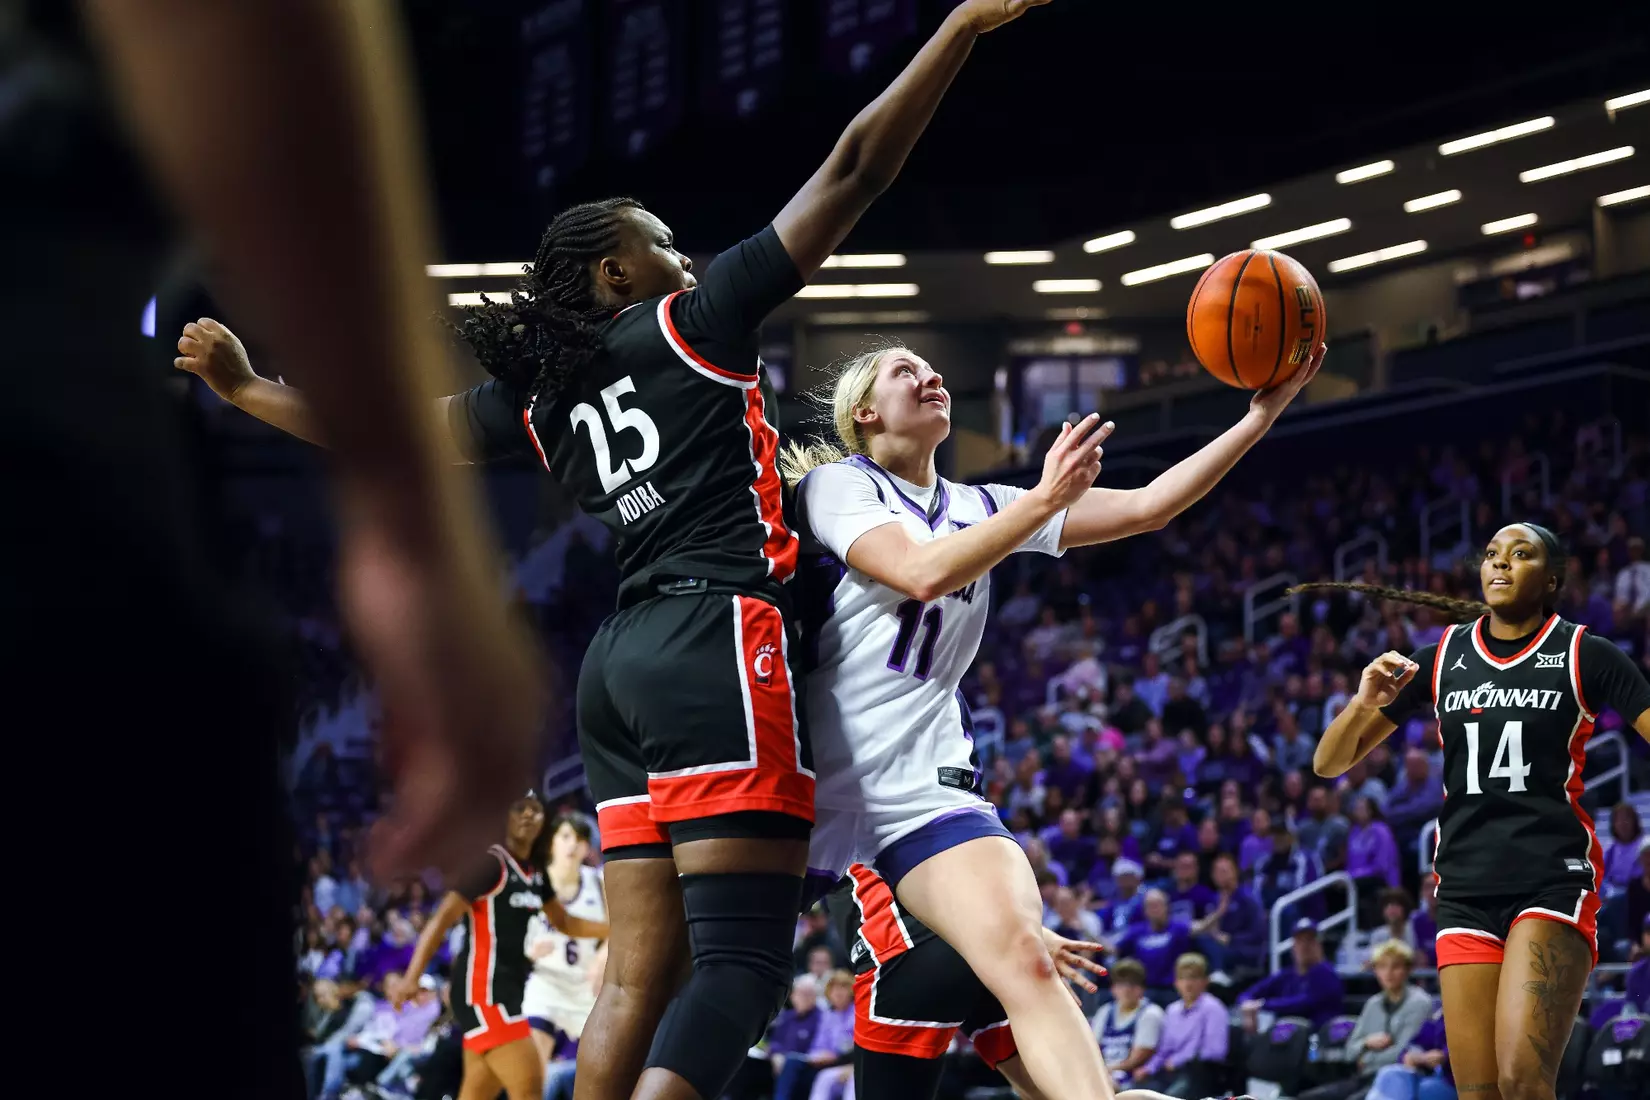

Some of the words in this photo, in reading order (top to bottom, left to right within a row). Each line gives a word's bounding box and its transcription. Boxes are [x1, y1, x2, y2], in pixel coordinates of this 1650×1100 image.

[570, 375, 660, 495] 25
[616, 481, 666, 526] NDIBA
[886, 597, 944, 681] 11
[1538, 655, 1563, 667] XII
[1445, 687, 1563, 712] CINCINNATI
[1463, 720, 1532, 795] 14
[565, 938, 579, 965] 6
